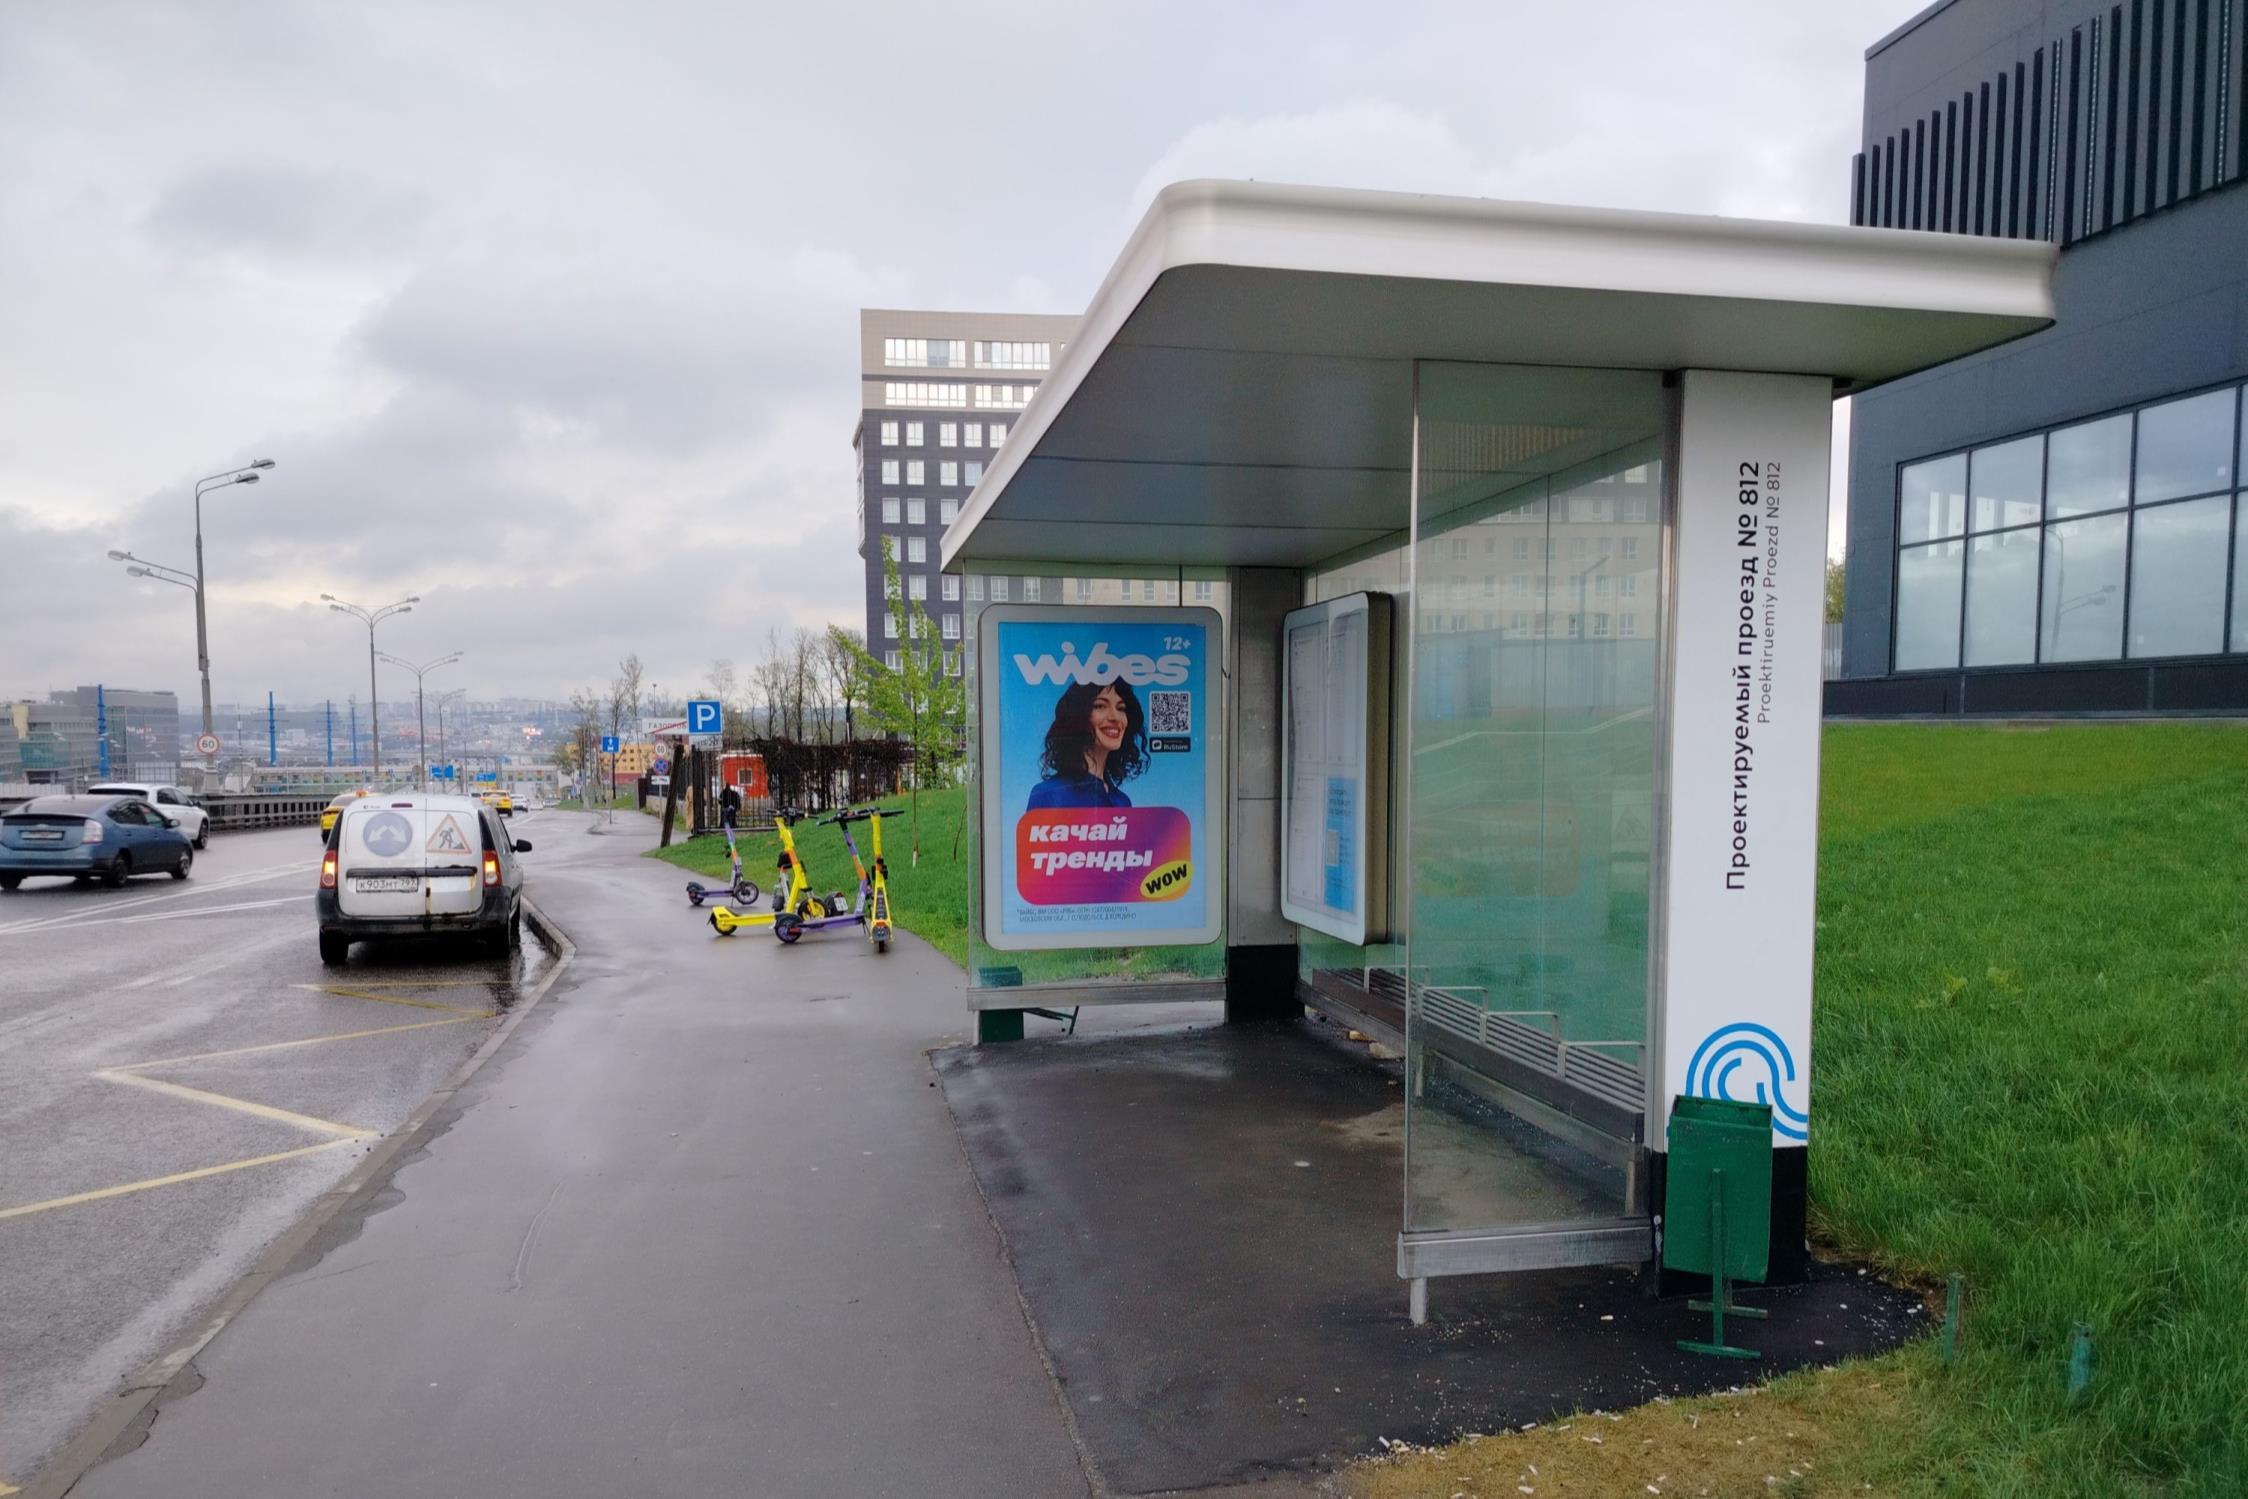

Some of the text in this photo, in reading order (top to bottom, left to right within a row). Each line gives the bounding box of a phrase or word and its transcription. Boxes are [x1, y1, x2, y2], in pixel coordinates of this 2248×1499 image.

[1757, 462, 1781, 724] Proektiruemiy Proezd № 812
[1163, 636, 1192, 651] 12+
[1726, 461, 1759, 890] Проектируемый проезд № 812
[202, 739, 215, 749] 60
[1029, 815, 1128, 843] качай
[1030, 850, 1153, 876] тренды
